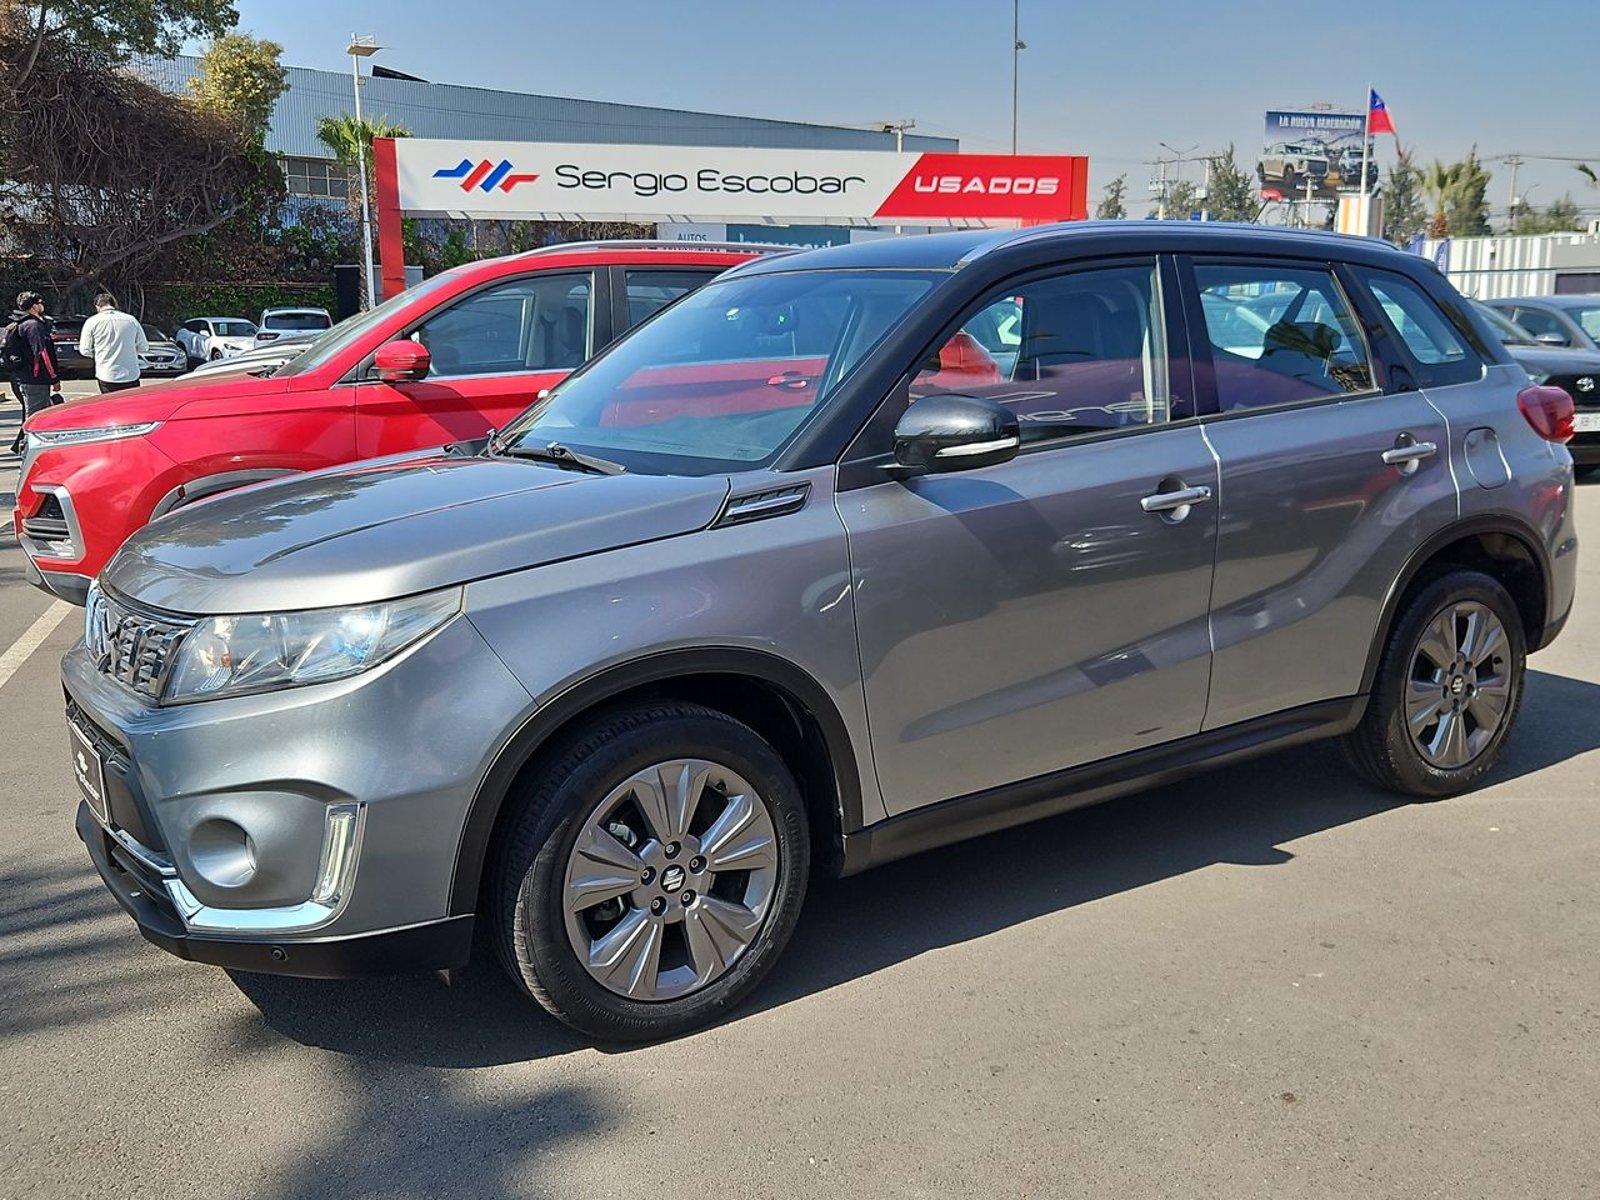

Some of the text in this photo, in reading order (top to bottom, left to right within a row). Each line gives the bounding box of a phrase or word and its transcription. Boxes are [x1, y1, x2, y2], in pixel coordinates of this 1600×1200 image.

[555, 165, 866, 196] Sergio Escobar
[914, 176, 1060, 195] USADOS
[677, 233, 708, 242] AUTOS
